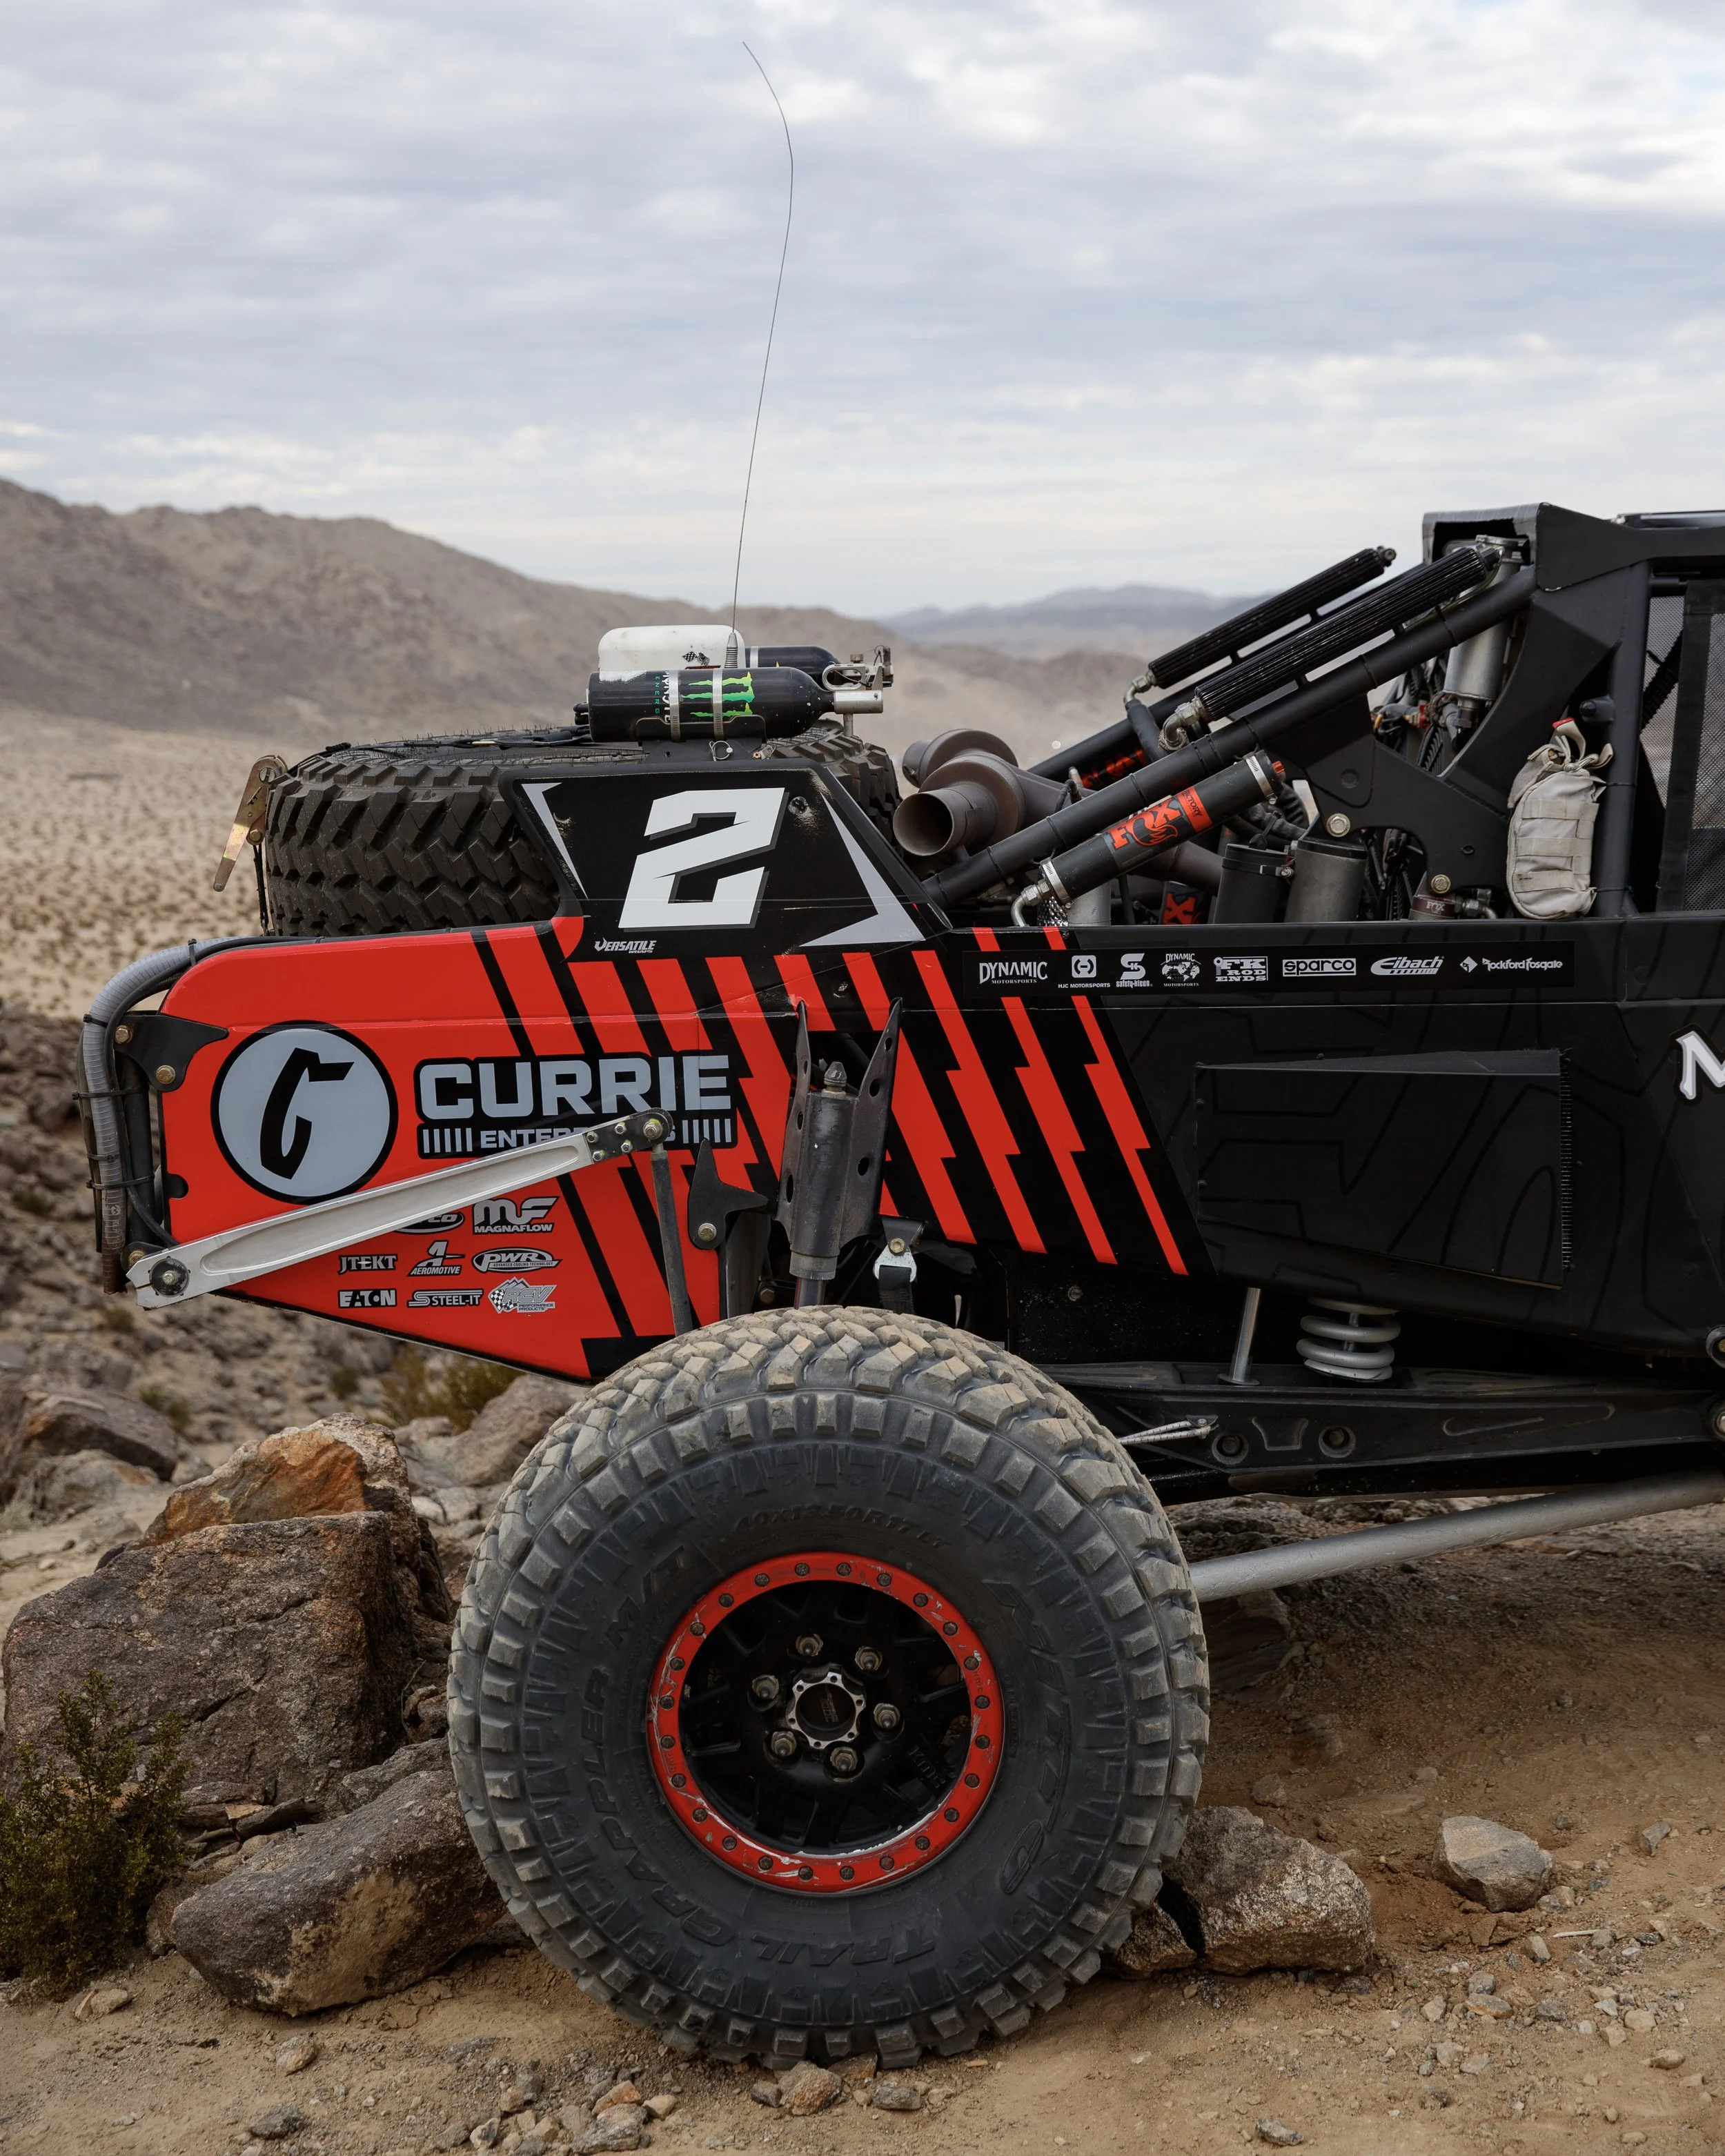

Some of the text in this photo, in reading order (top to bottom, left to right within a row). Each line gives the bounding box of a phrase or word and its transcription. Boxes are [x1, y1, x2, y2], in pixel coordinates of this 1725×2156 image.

[1106, 798, 1183, 850] FOX
[618, 787, 785, 928] 2
[594, 937, 657, 951] VERSATILE
[1165, 953, 1195, 963] DYNAMIC
[1221, 958, 1265, 969] FK
[979, 961, 1048, 984] DYNAMIC
[1284, 960, 1355, 976] sparco
[420, 1055, 731, 1120] CURRIE
[474, 1224, 553, 1233] MAGNAFLOW
[340, 1255, 397, 1273] JTEKT
[410, 1266, 460, 1276] AEROMOTIVE
[481, 1252, 539, 1272] PWR
[339, 1289, 396, 1307] EATON
[432, 1294, 481, 1306] STEEL-IT
[501, 1287, 554, 1303] RCV
[605, 1543, 687, 1650] M/T
[581, 1667, 737, 1946] GRAPPLER
[751, 1926, 936, 1966] TRAIL
